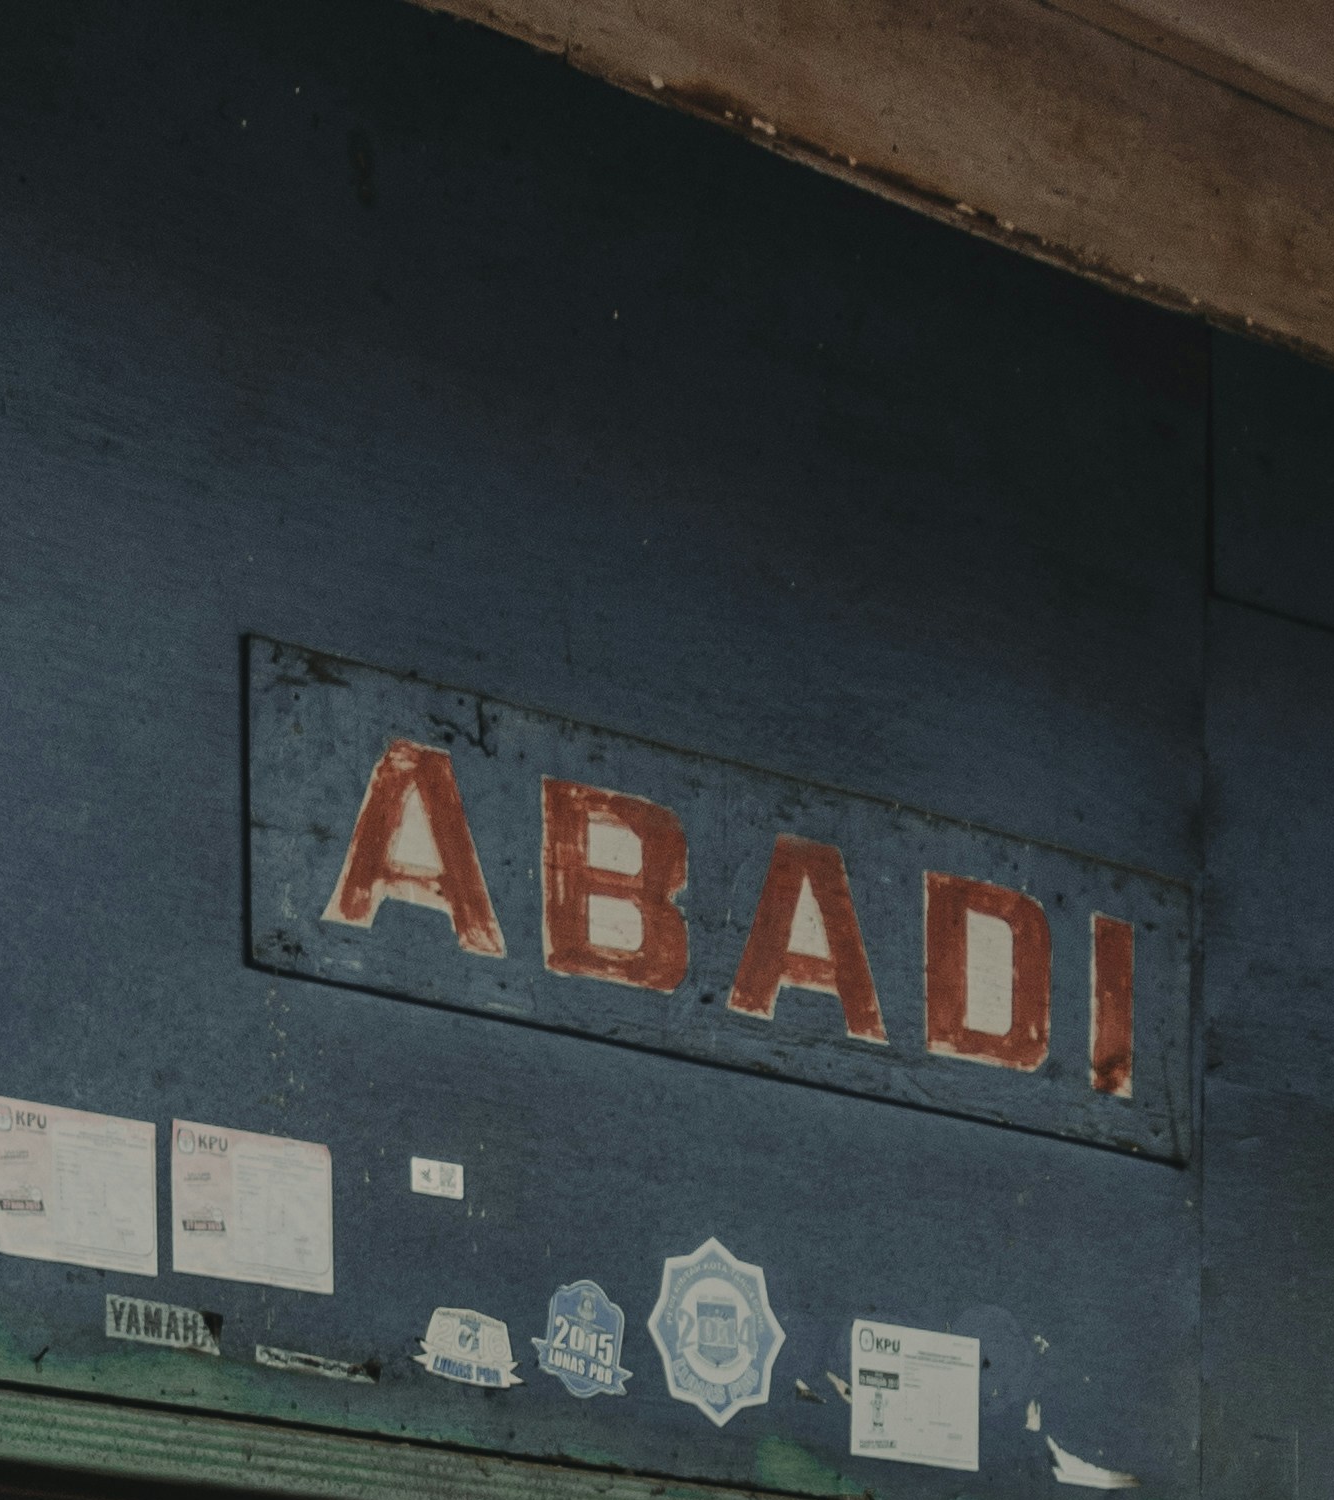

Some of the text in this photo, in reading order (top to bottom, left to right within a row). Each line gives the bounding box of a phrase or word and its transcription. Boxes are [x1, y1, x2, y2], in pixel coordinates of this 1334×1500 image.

[321, 737, 1133, 1099] ABADI
[15, 1110, 47, 1129] KPU
[198, 1133, 228, 1152] KPU
[553, 1315, 614, 1367] 2015
[875, 1337, 901, 1353] KPU
[547, 1347, 586, 1376] LUNAS
